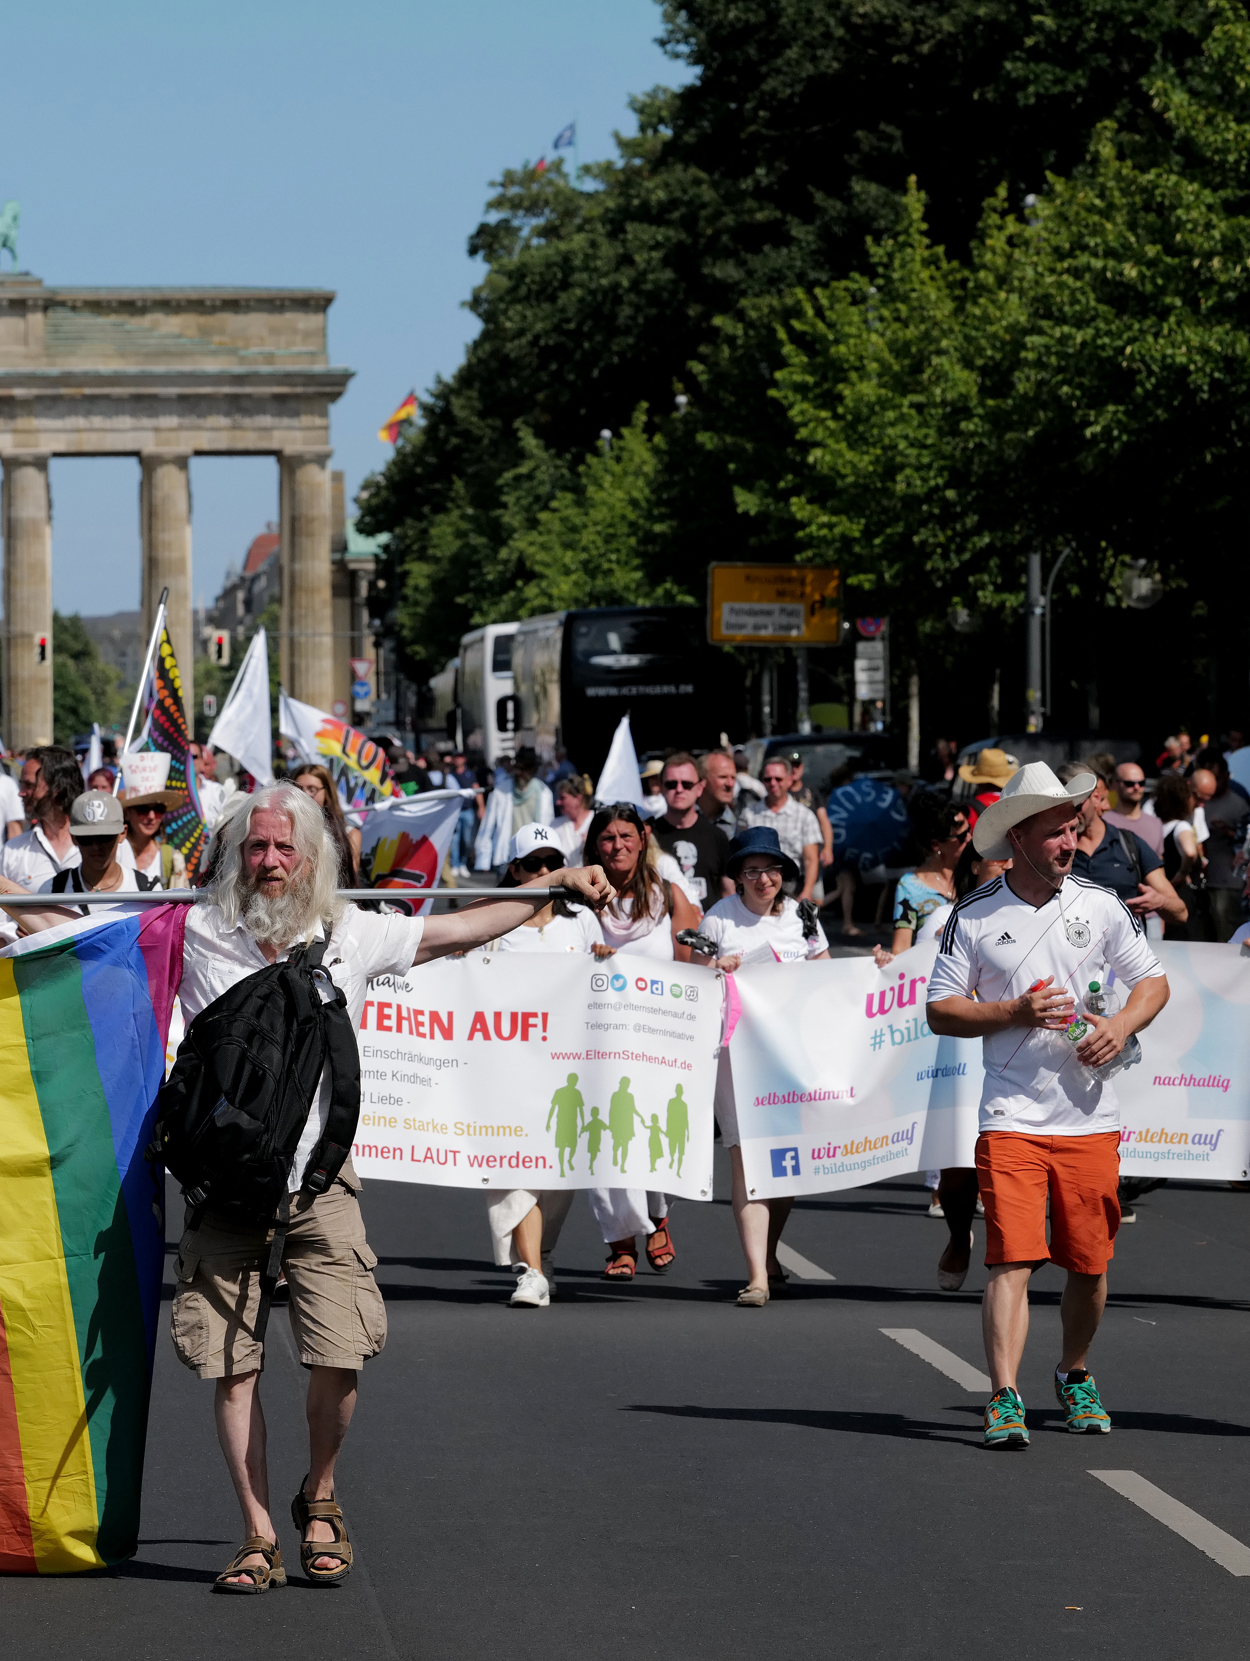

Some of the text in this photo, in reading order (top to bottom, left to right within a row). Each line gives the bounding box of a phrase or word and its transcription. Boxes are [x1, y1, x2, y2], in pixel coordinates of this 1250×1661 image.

[995, 938, 1016, 946] adidas
[865, 972, 927, 1019] wir
[587, 1001, 697, 1021] eltern@elternstehenauf.de
[467, 1011, 549, 1042] AUF!
[585, 1021, 695, 1042] Telegram: @ElternInitiative
[363, 1045, 459, 1070] Einschränkungen
[550, 1050, 693, 1071] www.ElternStehenAuf.de
[391, 1070, 432, 1088] Kindheit
[1153, 1073, 1231, 1093] nachhaltig
[370, 1092, 403, 1106] Liebe
[753, 1086, 856, 1107] selbstbestimmt
[362, 1111, 529, 1137] eine starke Stimme.
[891, 1121, 918, 1146] auf
[1191, 1128, 1224, 1152] auf
[411, 1145, 461, 1167] LAUT
[468, 1151, 553, 1169] werden.
[813, 1147, 909, 1176] #bildungsfreiheit
